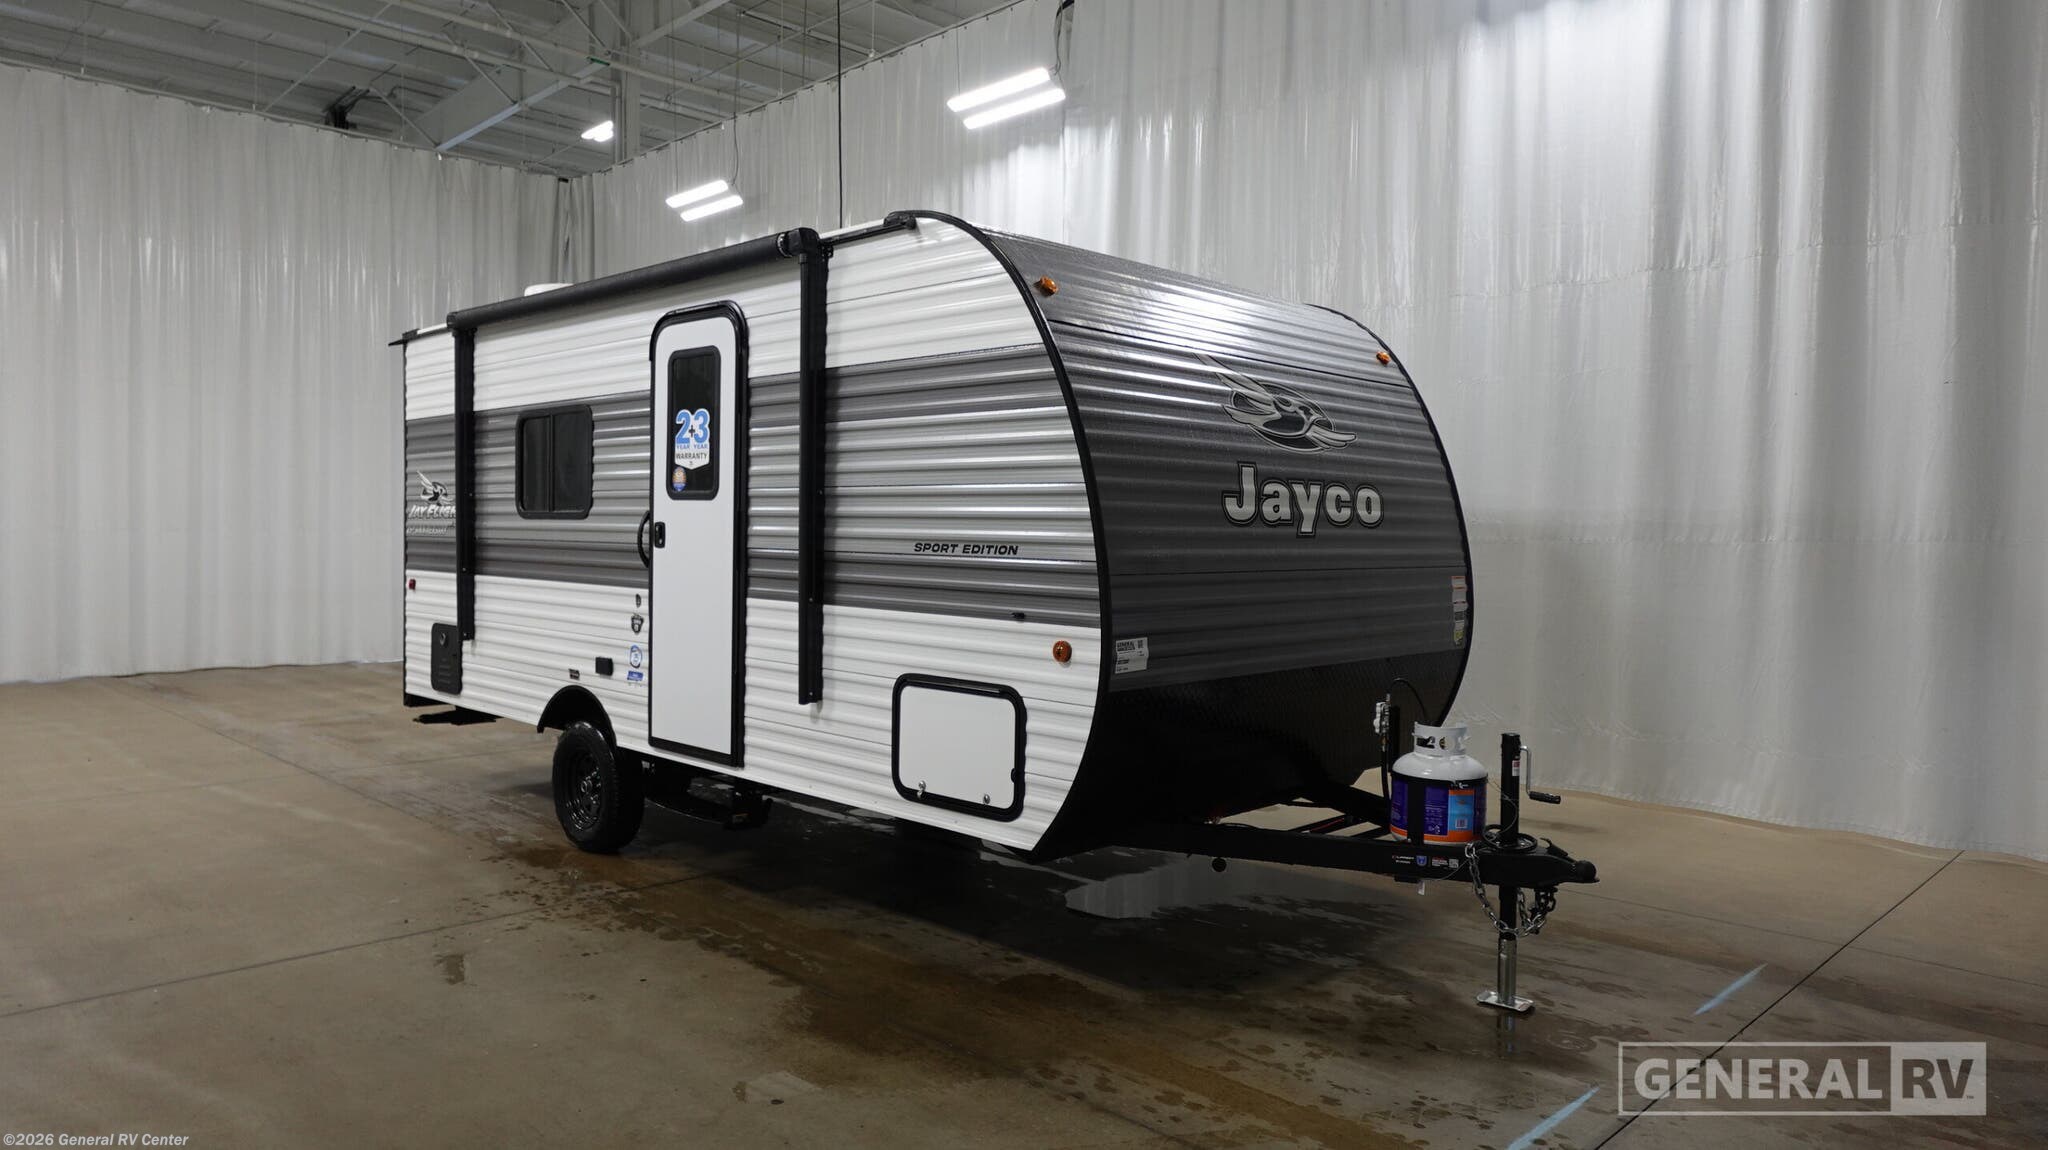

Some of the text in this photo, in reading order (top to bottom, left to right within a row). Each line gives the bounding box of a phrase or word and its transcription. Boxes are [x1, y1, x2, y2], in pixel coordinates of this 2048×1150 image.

[1223, 462, 1383, 537] Jayco
[427, 504, 456, 518] FLIGH
[914, 543, 1019, 555] SPORT EDITION
